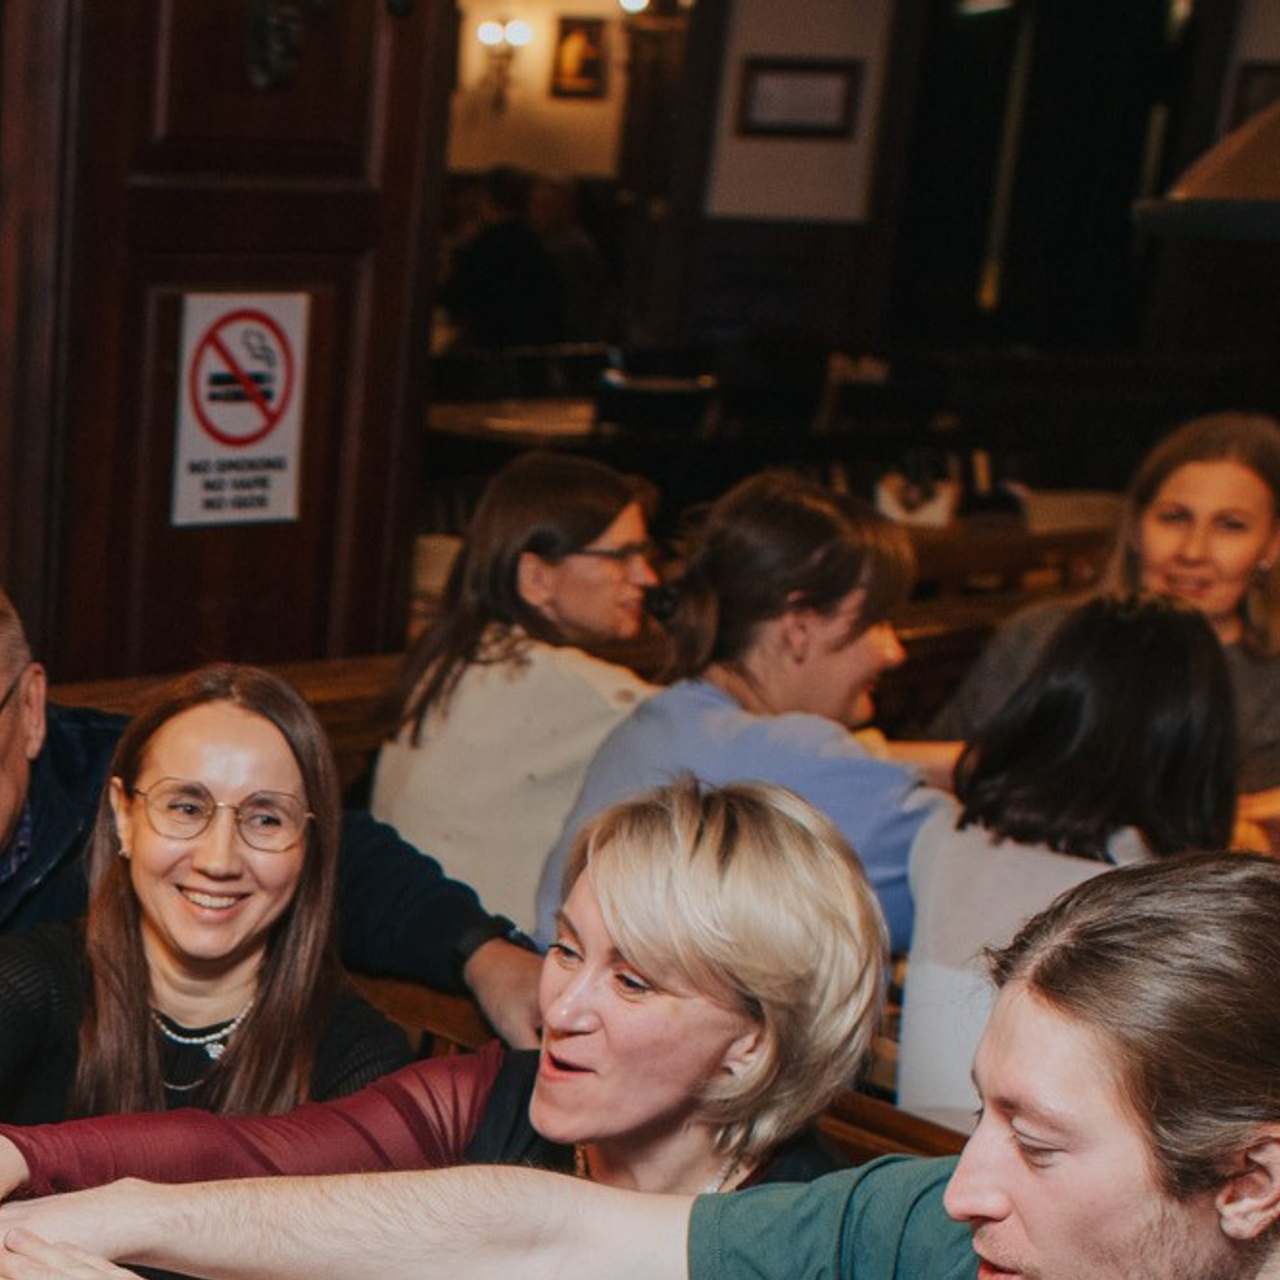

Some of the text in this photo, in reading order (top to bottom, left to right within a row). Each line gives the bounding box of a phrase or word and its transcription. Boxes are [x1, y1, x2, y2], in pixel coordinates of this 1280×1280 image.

[189, 456, 287, 473] NO SMOKING
[203, 475, 270, 491] NO VAPE
[202, 495, 225, 509] NO
